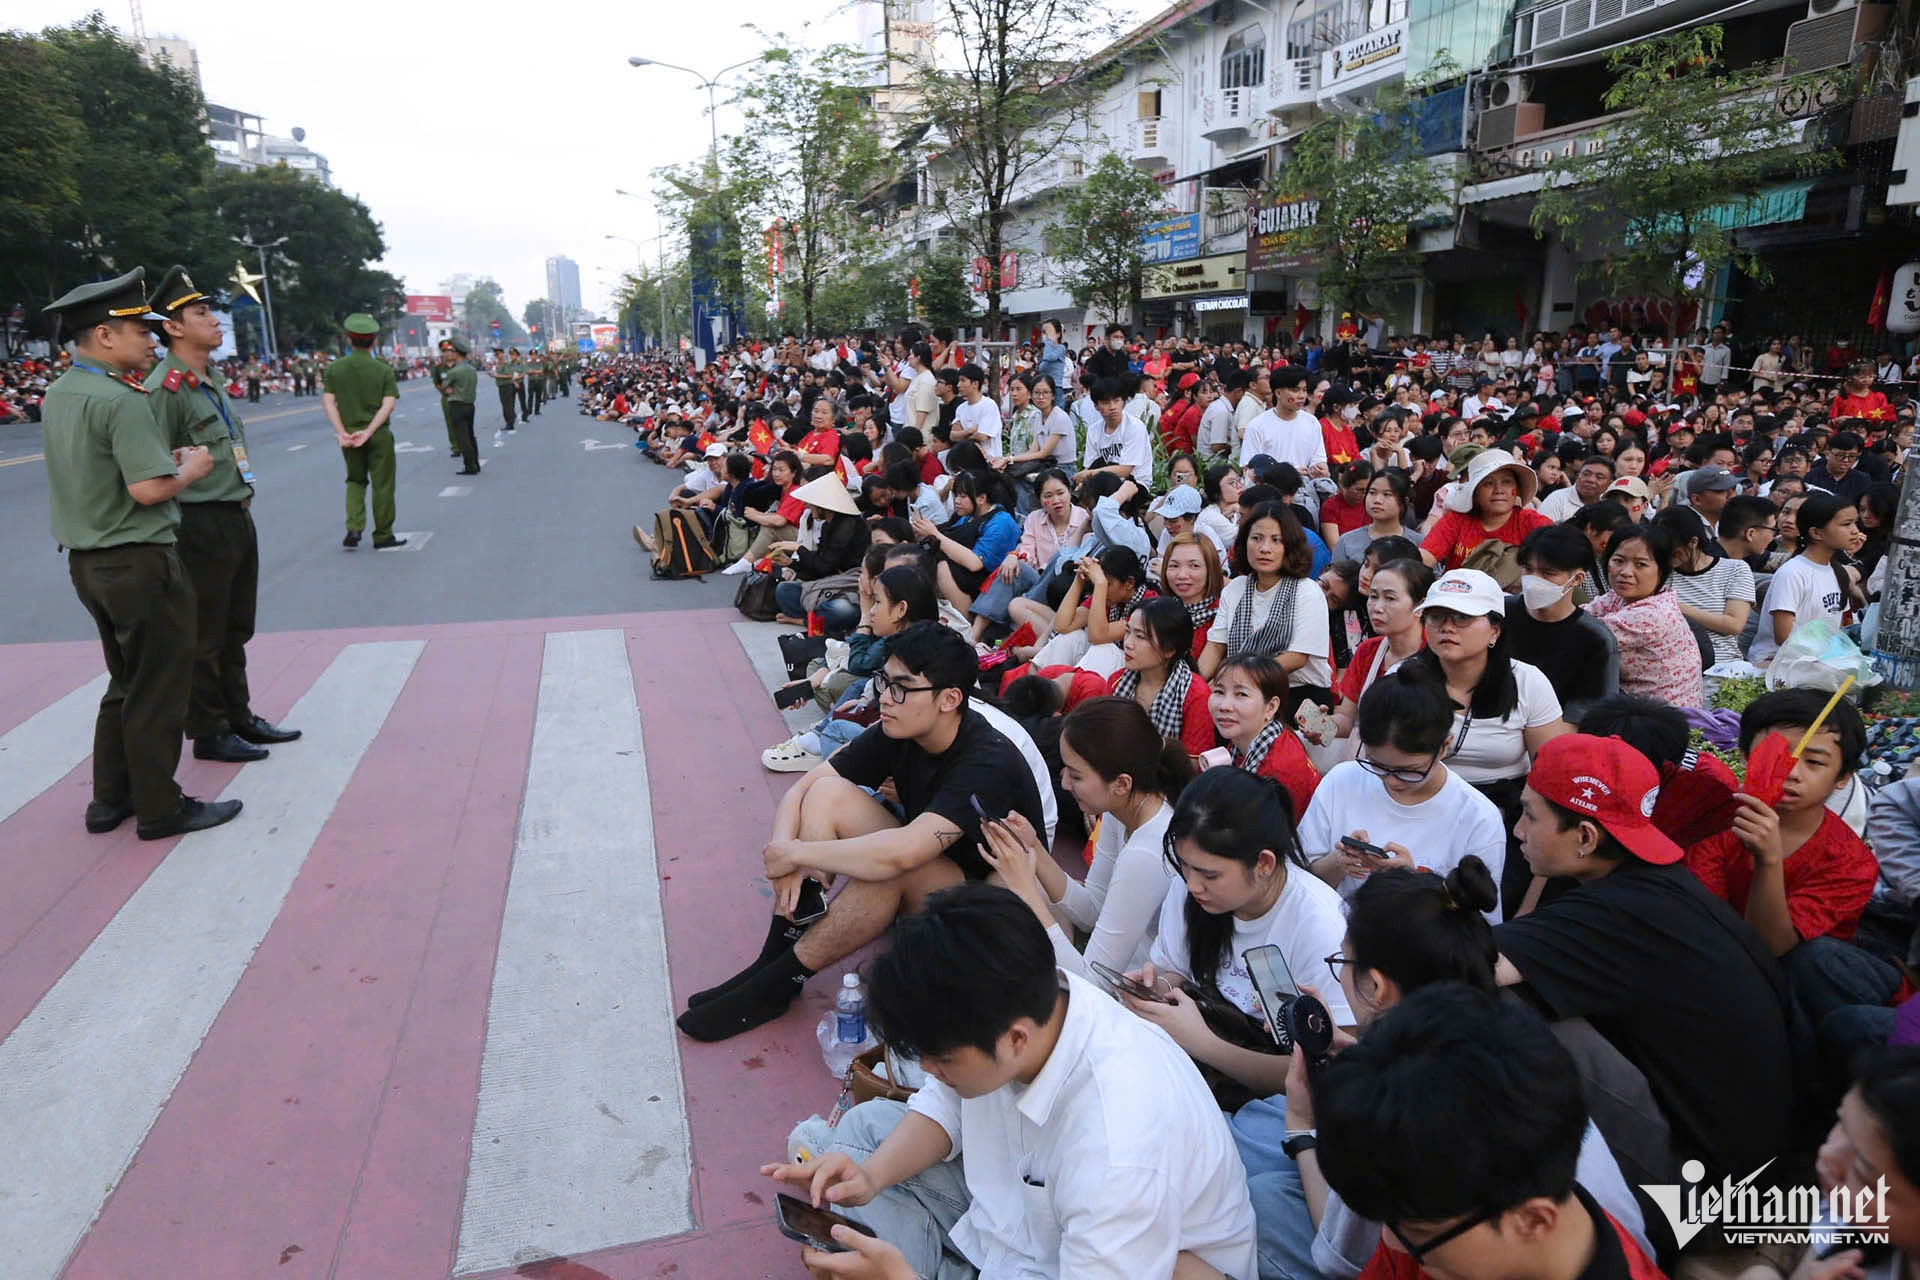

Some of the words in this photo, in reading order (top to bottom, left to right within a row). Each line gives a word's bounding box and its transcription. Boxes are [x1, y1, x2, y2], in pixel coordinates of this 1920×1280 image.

[1347, 29, 1401, 61] GUJARAT
[1258, 200, 1320, 235] GUJARAT
[1195, 300, 1219, 312] VIETNAM
[1219, 297, 1249, 310] CHOCOLATE
[1571, 776, 1612, 795] WHENEVER
[1569, 797, 1598, 812] ATELIER
